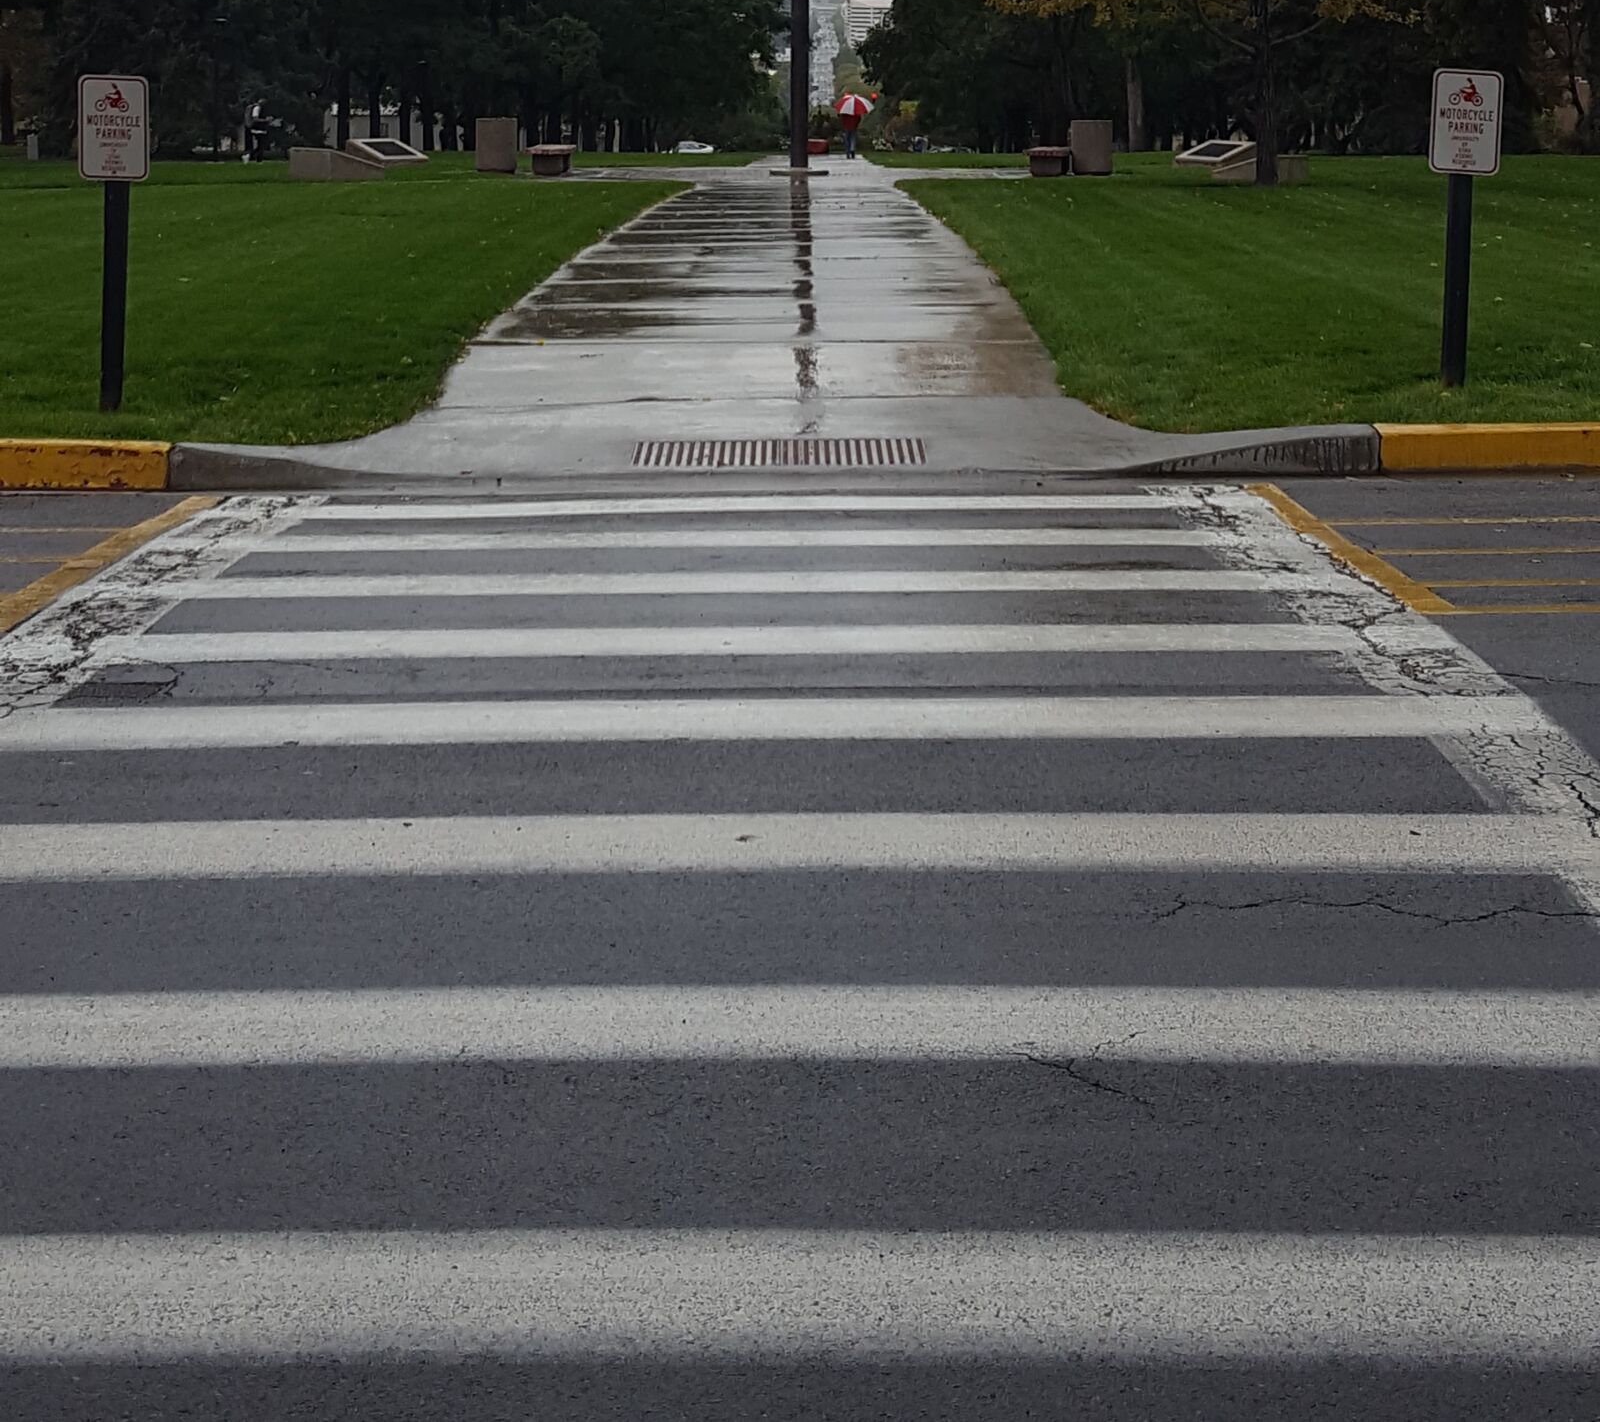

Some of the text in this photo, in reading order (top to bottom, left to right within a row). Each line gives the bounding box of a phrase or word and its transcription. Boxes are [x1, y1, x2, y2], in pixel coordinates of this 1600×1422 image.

[86, 114, 140, 127] MOTORCYCLE
[1440, 108, 1494, 122] MOTORCYCLE
[96, 128, 131, 140] PARKING
[1448, 121, 1484, 134] PARKING
